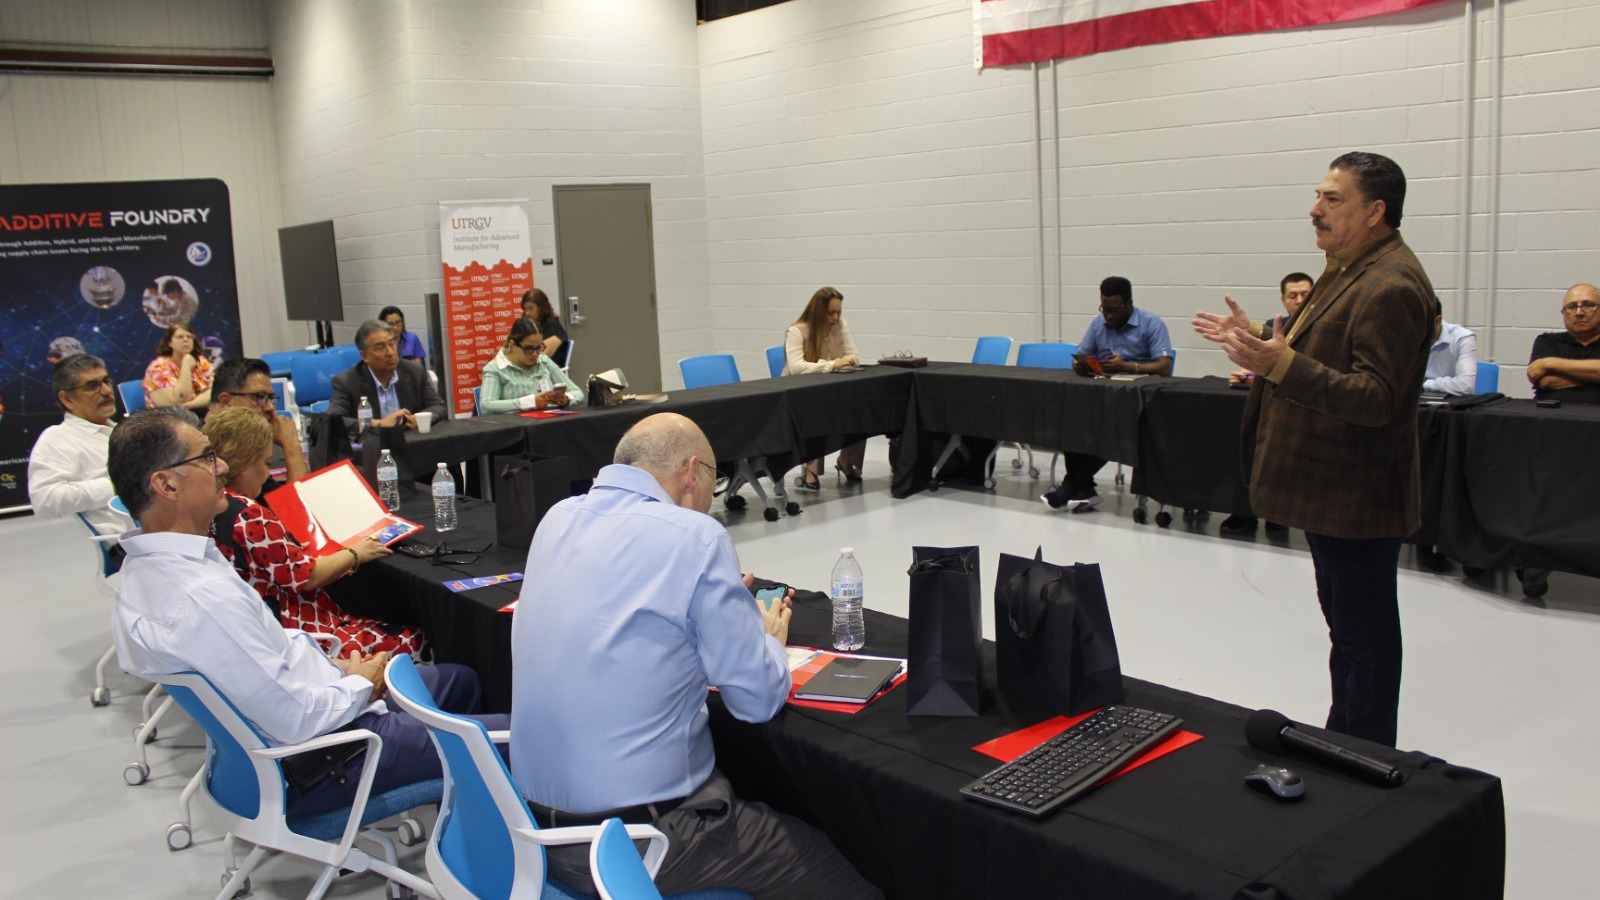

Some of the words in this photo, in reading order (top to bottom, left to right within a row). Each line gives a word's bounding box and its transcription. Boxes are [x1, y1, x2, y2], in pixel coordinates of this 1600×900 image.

[109, 208, 210, 227] FOUNDRY
[451, 217, 492, 230] UTRGV
[0, 240, 21, 248] hrough
[53, 238, 76, 246] Hybrid,
[453, 235, 479, 243] Institute
[480, 234, 489, 243] for
[490, 233, 520, 241] Advanced
[453, 243, 499, 251] Manufacturing
